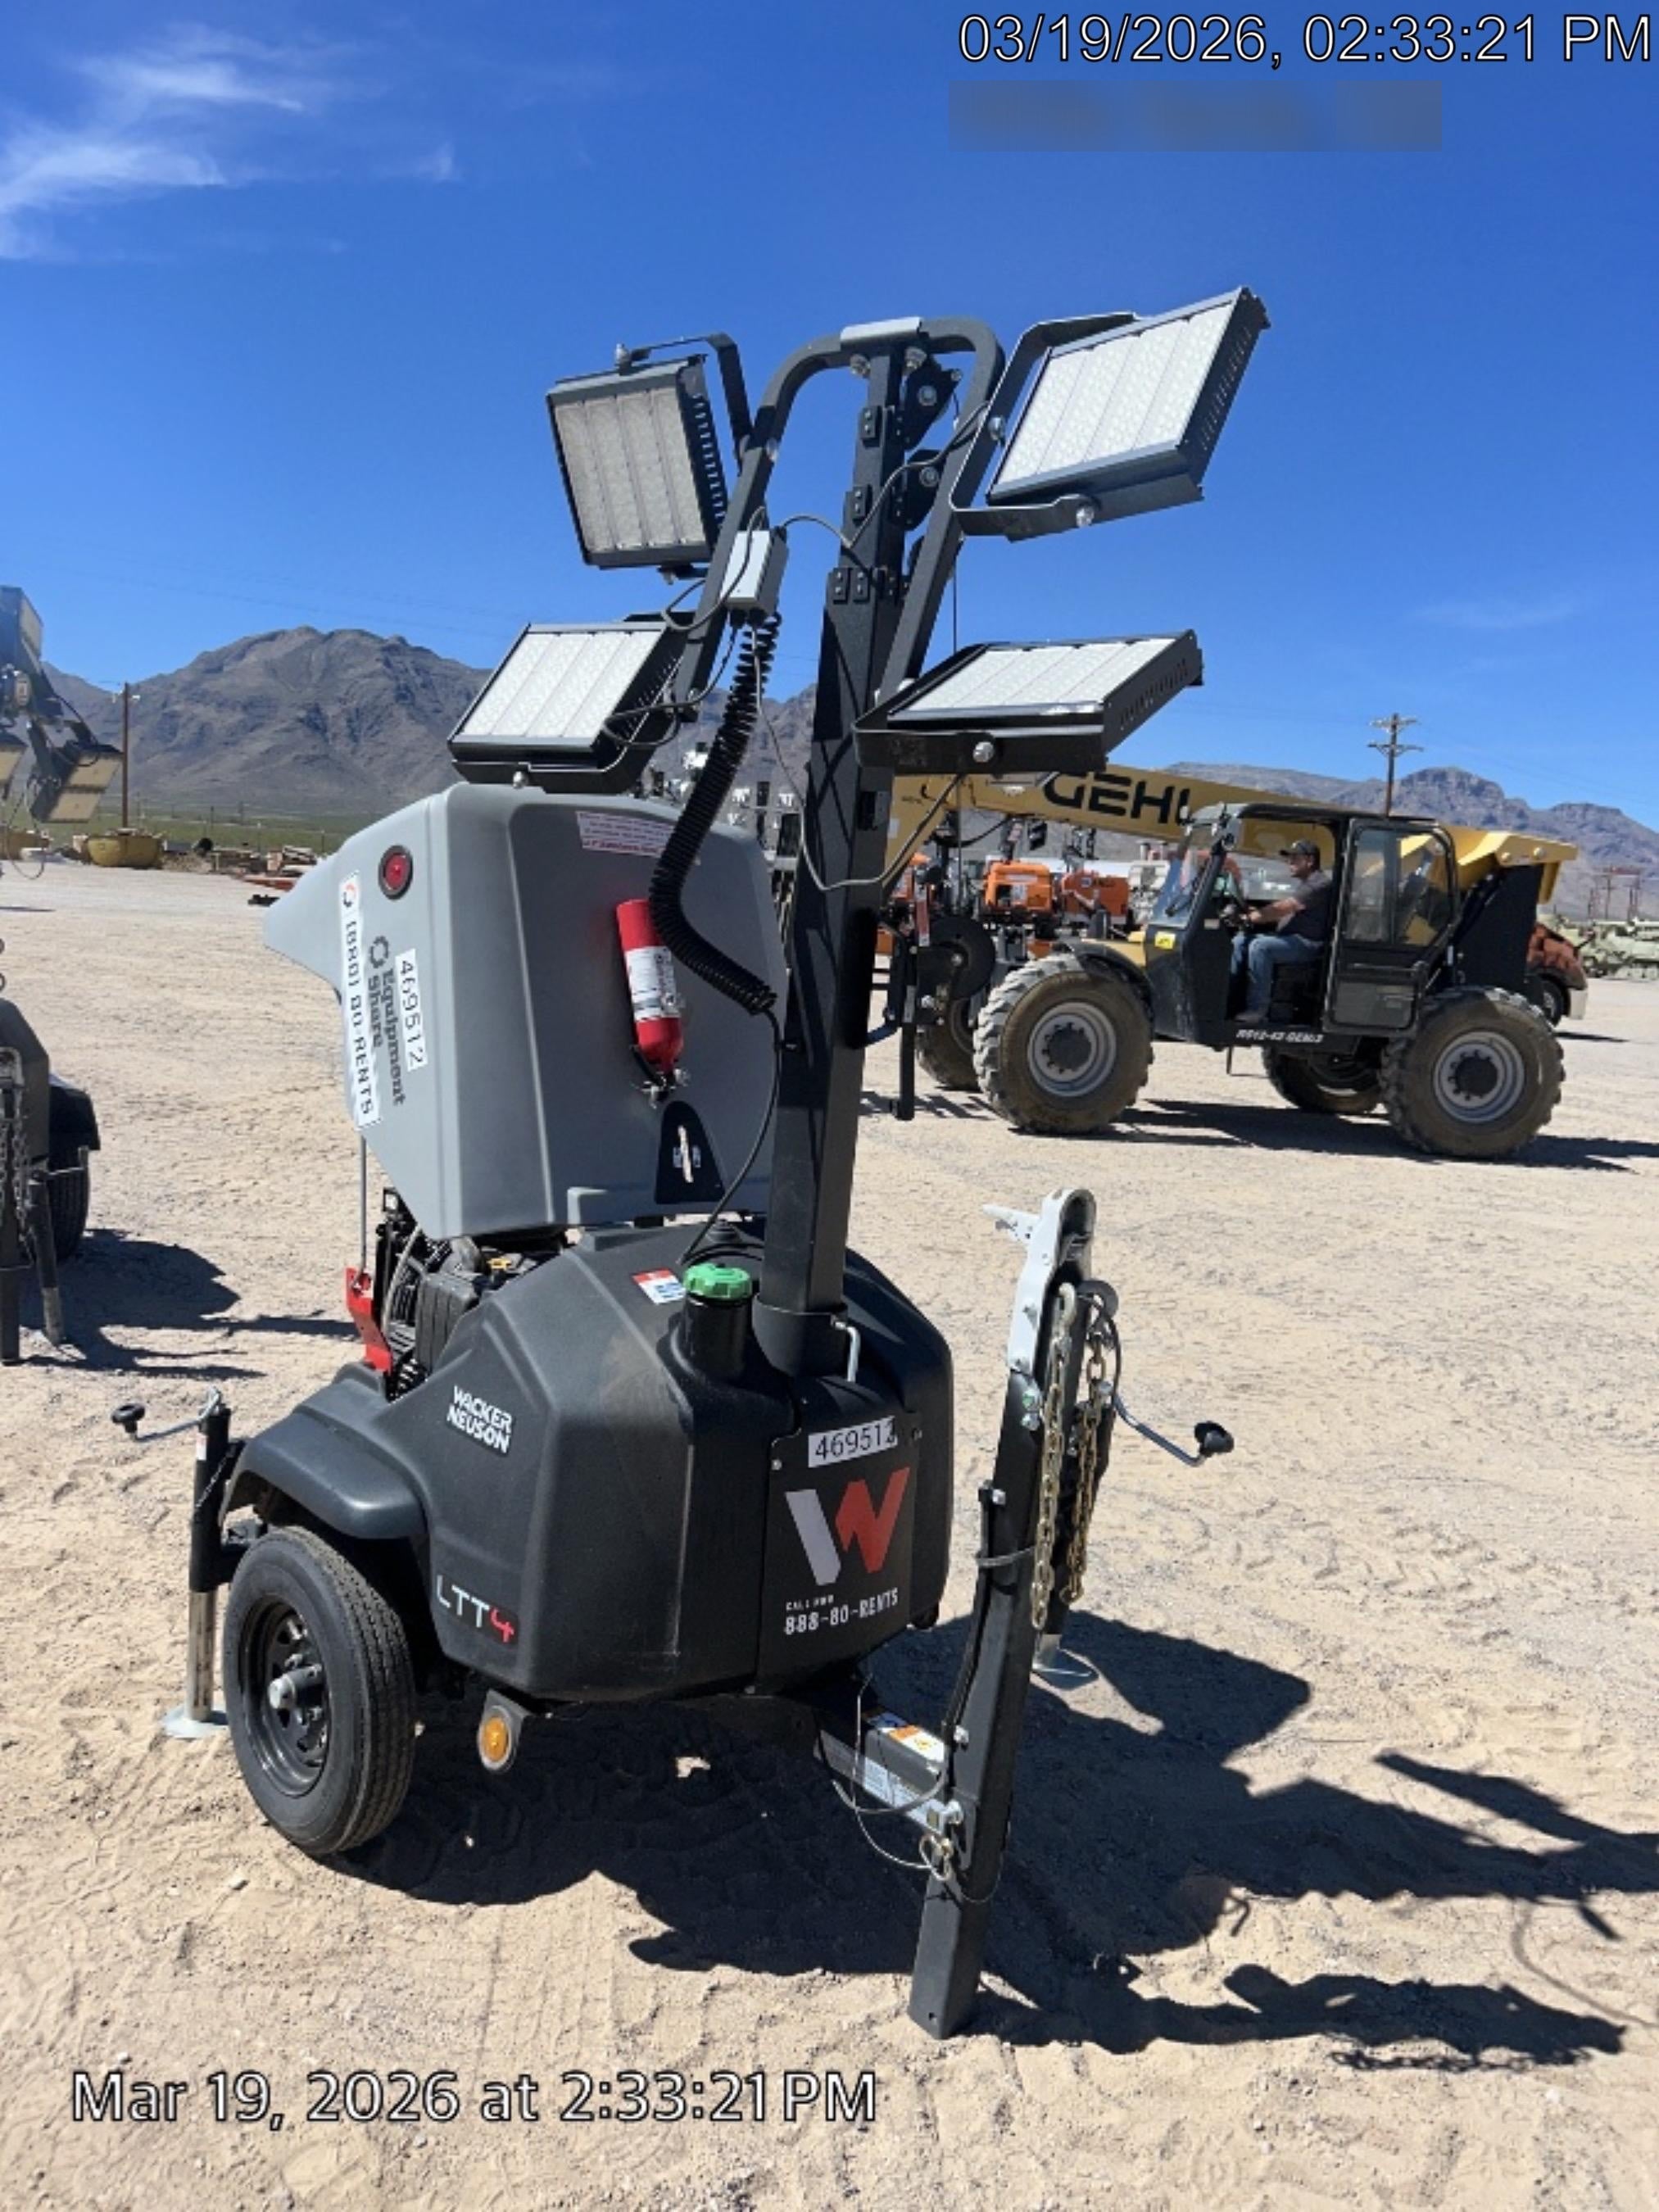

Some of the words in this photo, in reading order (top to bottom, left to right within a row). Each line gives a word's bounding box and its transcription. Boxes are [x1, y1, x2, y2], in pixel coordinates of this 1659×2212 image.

[369, 974, 383, 1049] Share
[382, 967, 406, 1106] Equipment
[400, 959, 424, 1066] 469512
[446, 1403, 511, 1454] NEUSON
[454, 1385, 513, 1434] WACKER
[436, 1574, 514, 1643] LTT4
[785, 1587, 899, 1635] 888-80-RENTS
